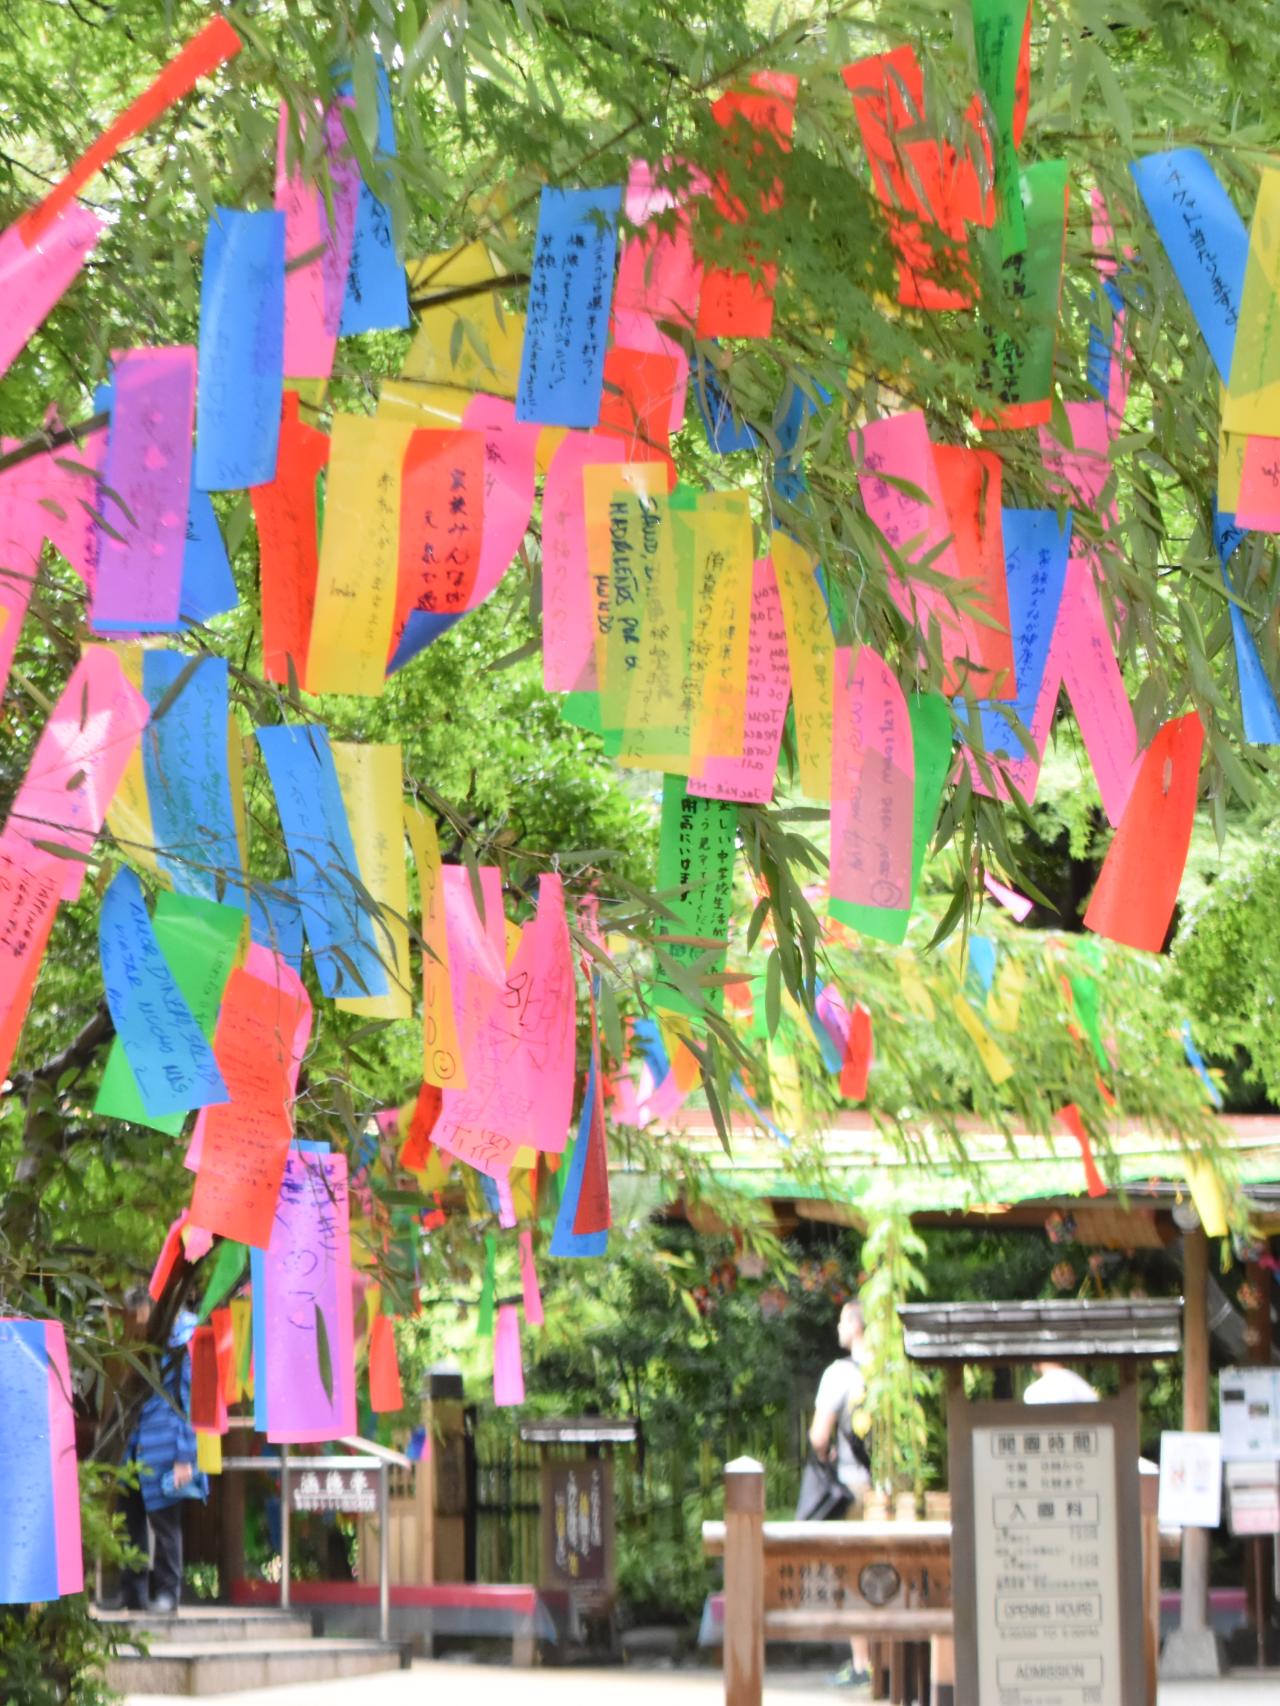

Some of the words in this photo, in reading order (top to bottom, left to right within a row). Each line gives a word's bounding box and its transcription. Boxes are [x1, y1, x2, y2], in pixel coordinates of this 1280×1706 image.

[1010, 1501, 1083, 1520] 入園料
[1004, 1601, 1051, 1617] OPENING
[1055, 1600, 1093, 1616] HOURS
[1016, 1664, 1085, 1680] ADMISSION
